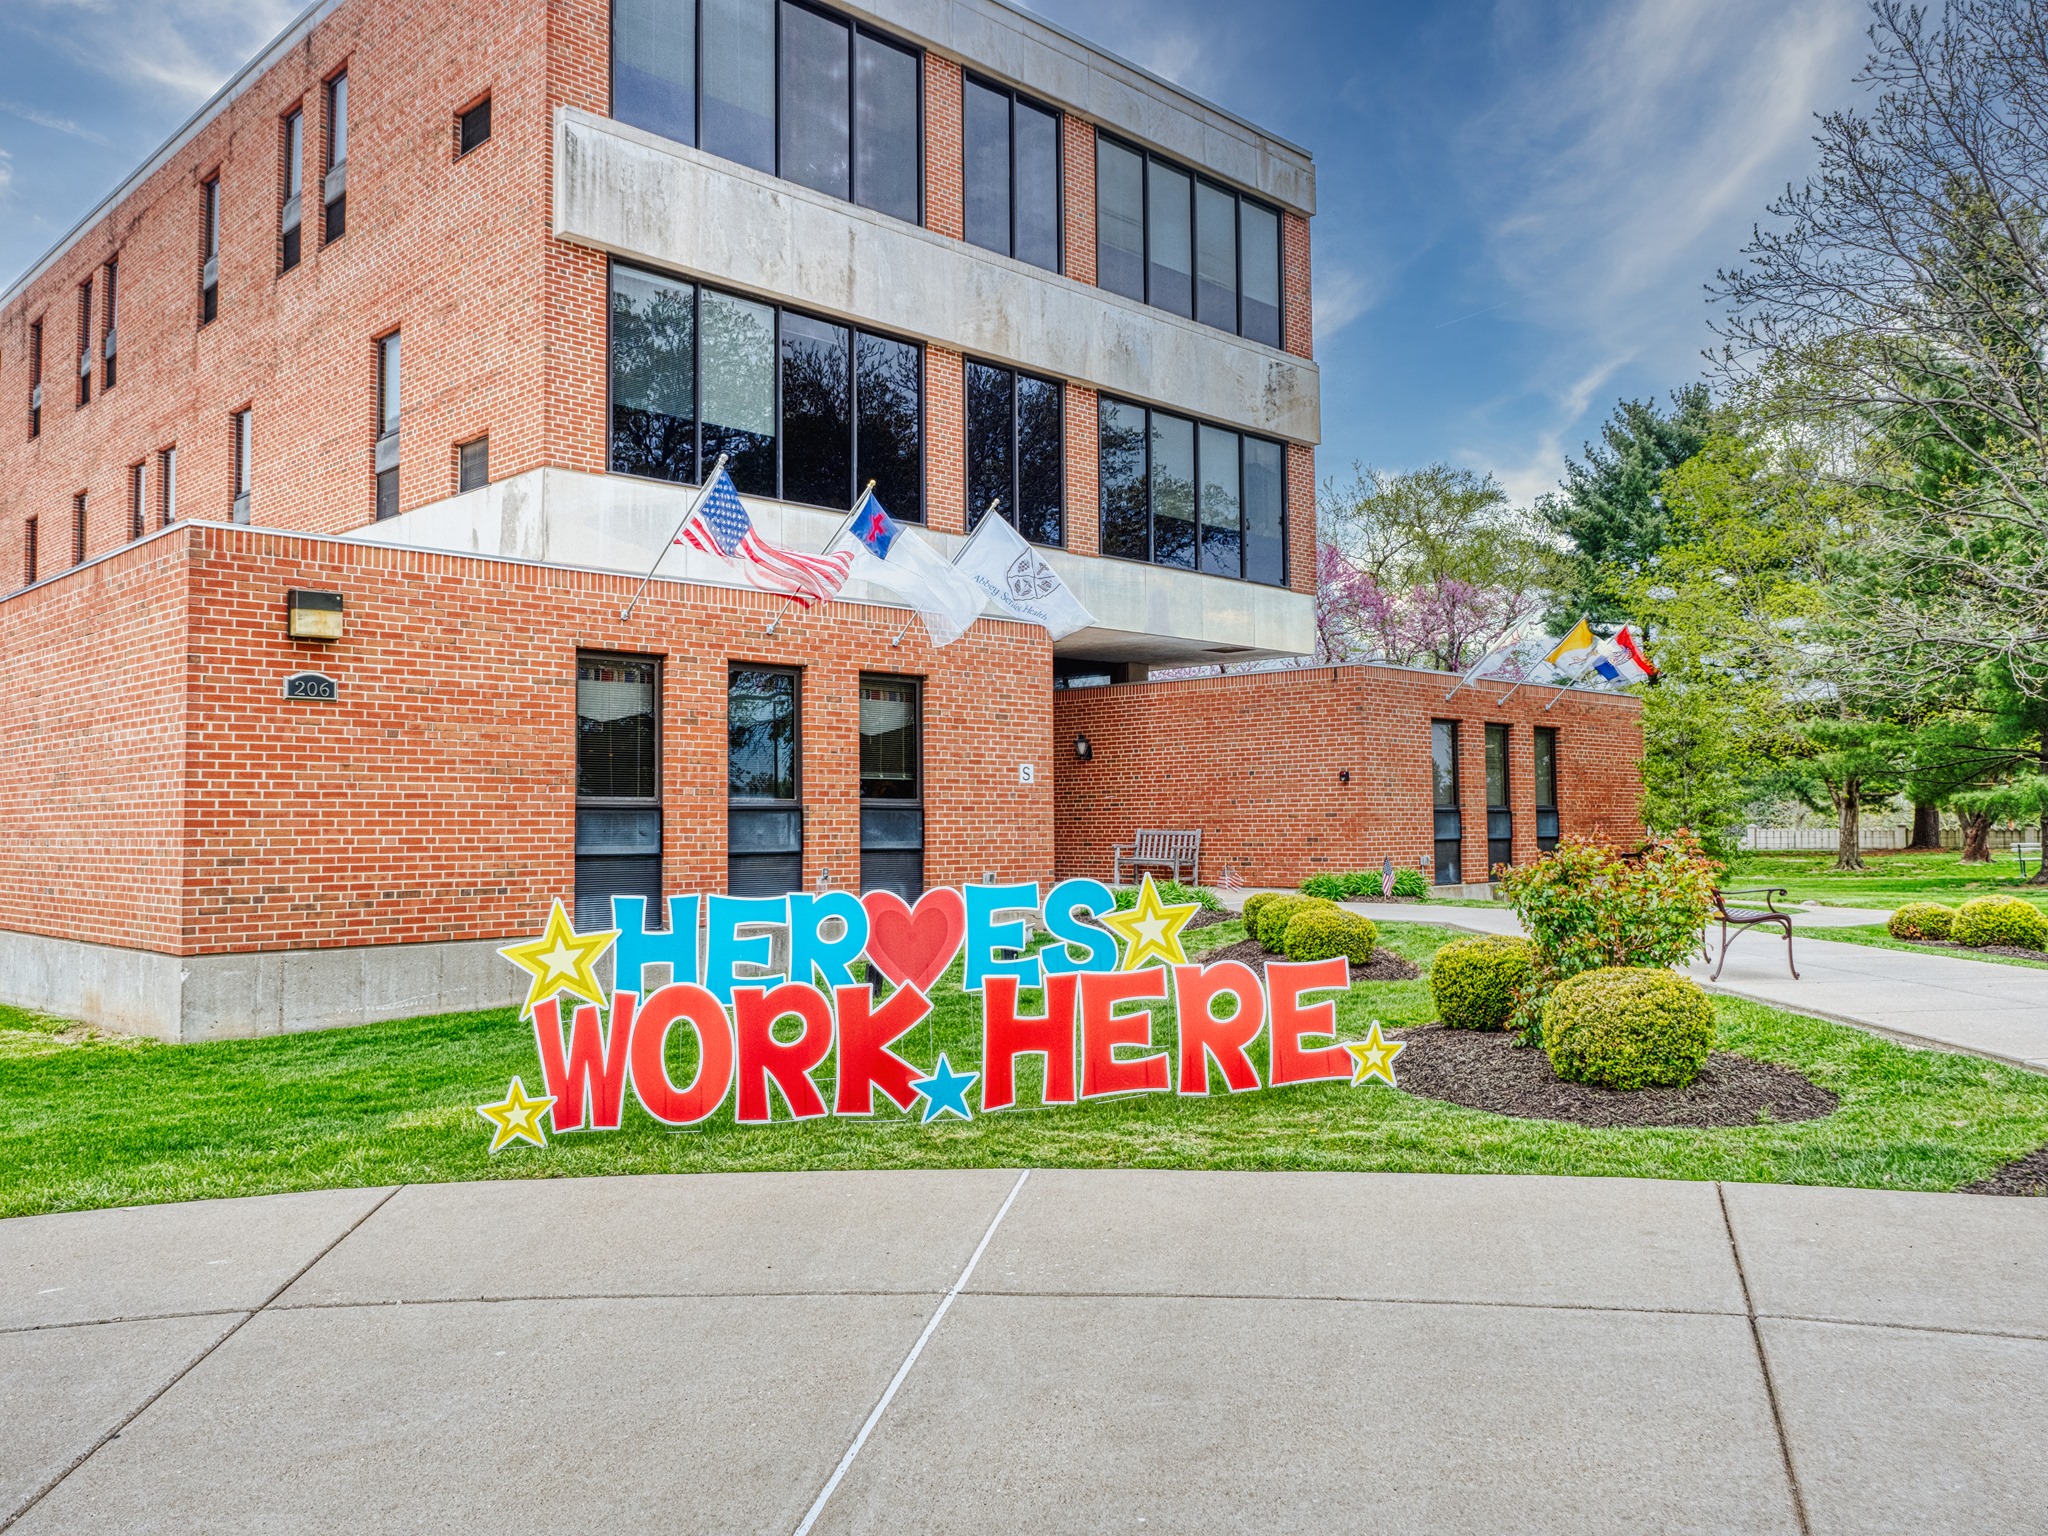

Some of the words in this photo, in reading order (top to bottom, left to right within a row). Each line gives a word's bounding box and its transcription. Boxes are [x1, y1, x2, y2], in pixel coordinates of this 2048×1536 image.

[974, 574, 1000, 596] Abbey
[1022, 605, 1048, 621] Health
[294, 681, 330, 697] 206
[1022, 766, 1031, 781] S
[532, 979, 934, 1133] WORK
[981, 956, 1355, 1112] HERE
